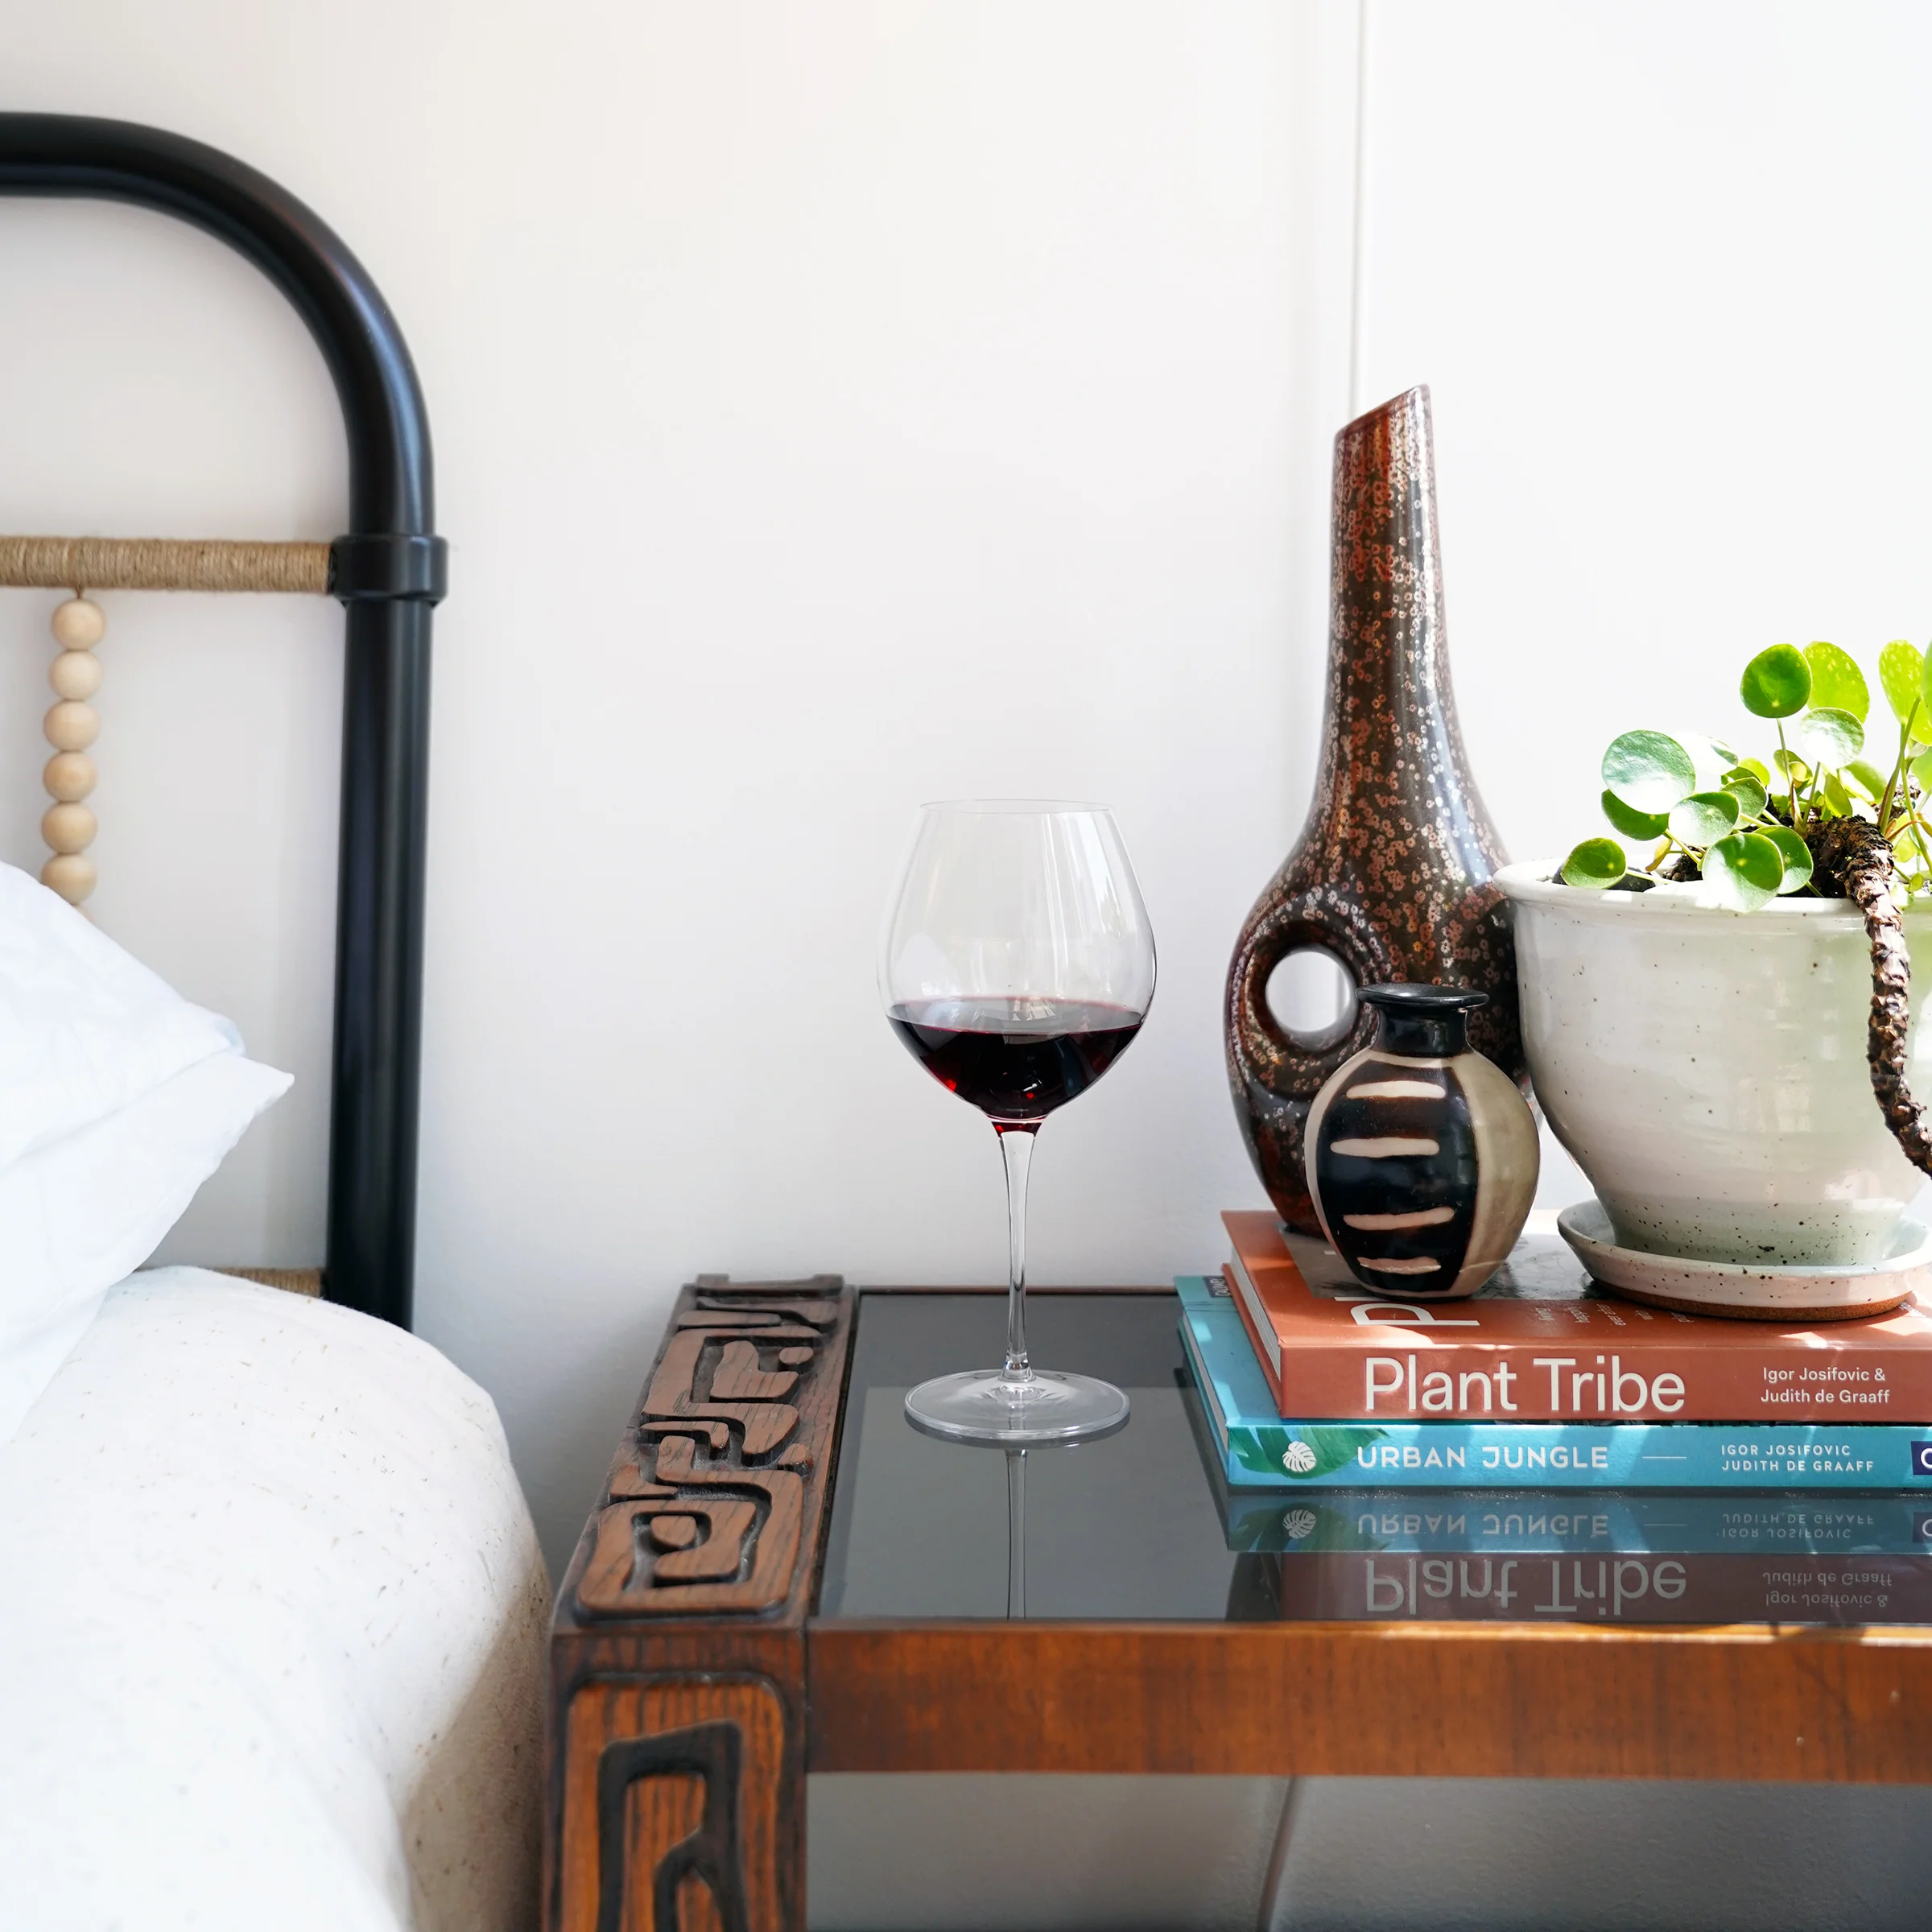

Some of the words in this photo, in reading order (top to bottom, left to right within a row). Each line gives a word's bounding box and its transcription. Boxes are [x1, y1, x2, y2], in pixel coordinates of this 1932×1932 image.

[1365, 1354, 1517, 1412] Plant
[1533, 1355, 1685, 1412] Tribe
[1763, 1367, 1795, 1384] Igor
[1798, 1366, 1869, 1381] Josifovic
[1874, 1368, 1886, 1381] &
[1761, 1388, 1810, 1403] Judith
[1814, 1389, 1835, 1402] de
[1839, 1389, 1890, 1403] Graaff
[1357, 1446, 1465, 1468] URBAN
[1482, 1446, 1608, 1468] JUNGLE
[1721, 1444, 1759, 1455] IGOR
[1765, 1444, 1851, 1456] JOSIFOVIC
[1722, 1460, 1779, 1472] JUDITH
[1786, 1460, 1806, 1472] DE
[1813, 1460, 1874, 1472] GRAAFF
